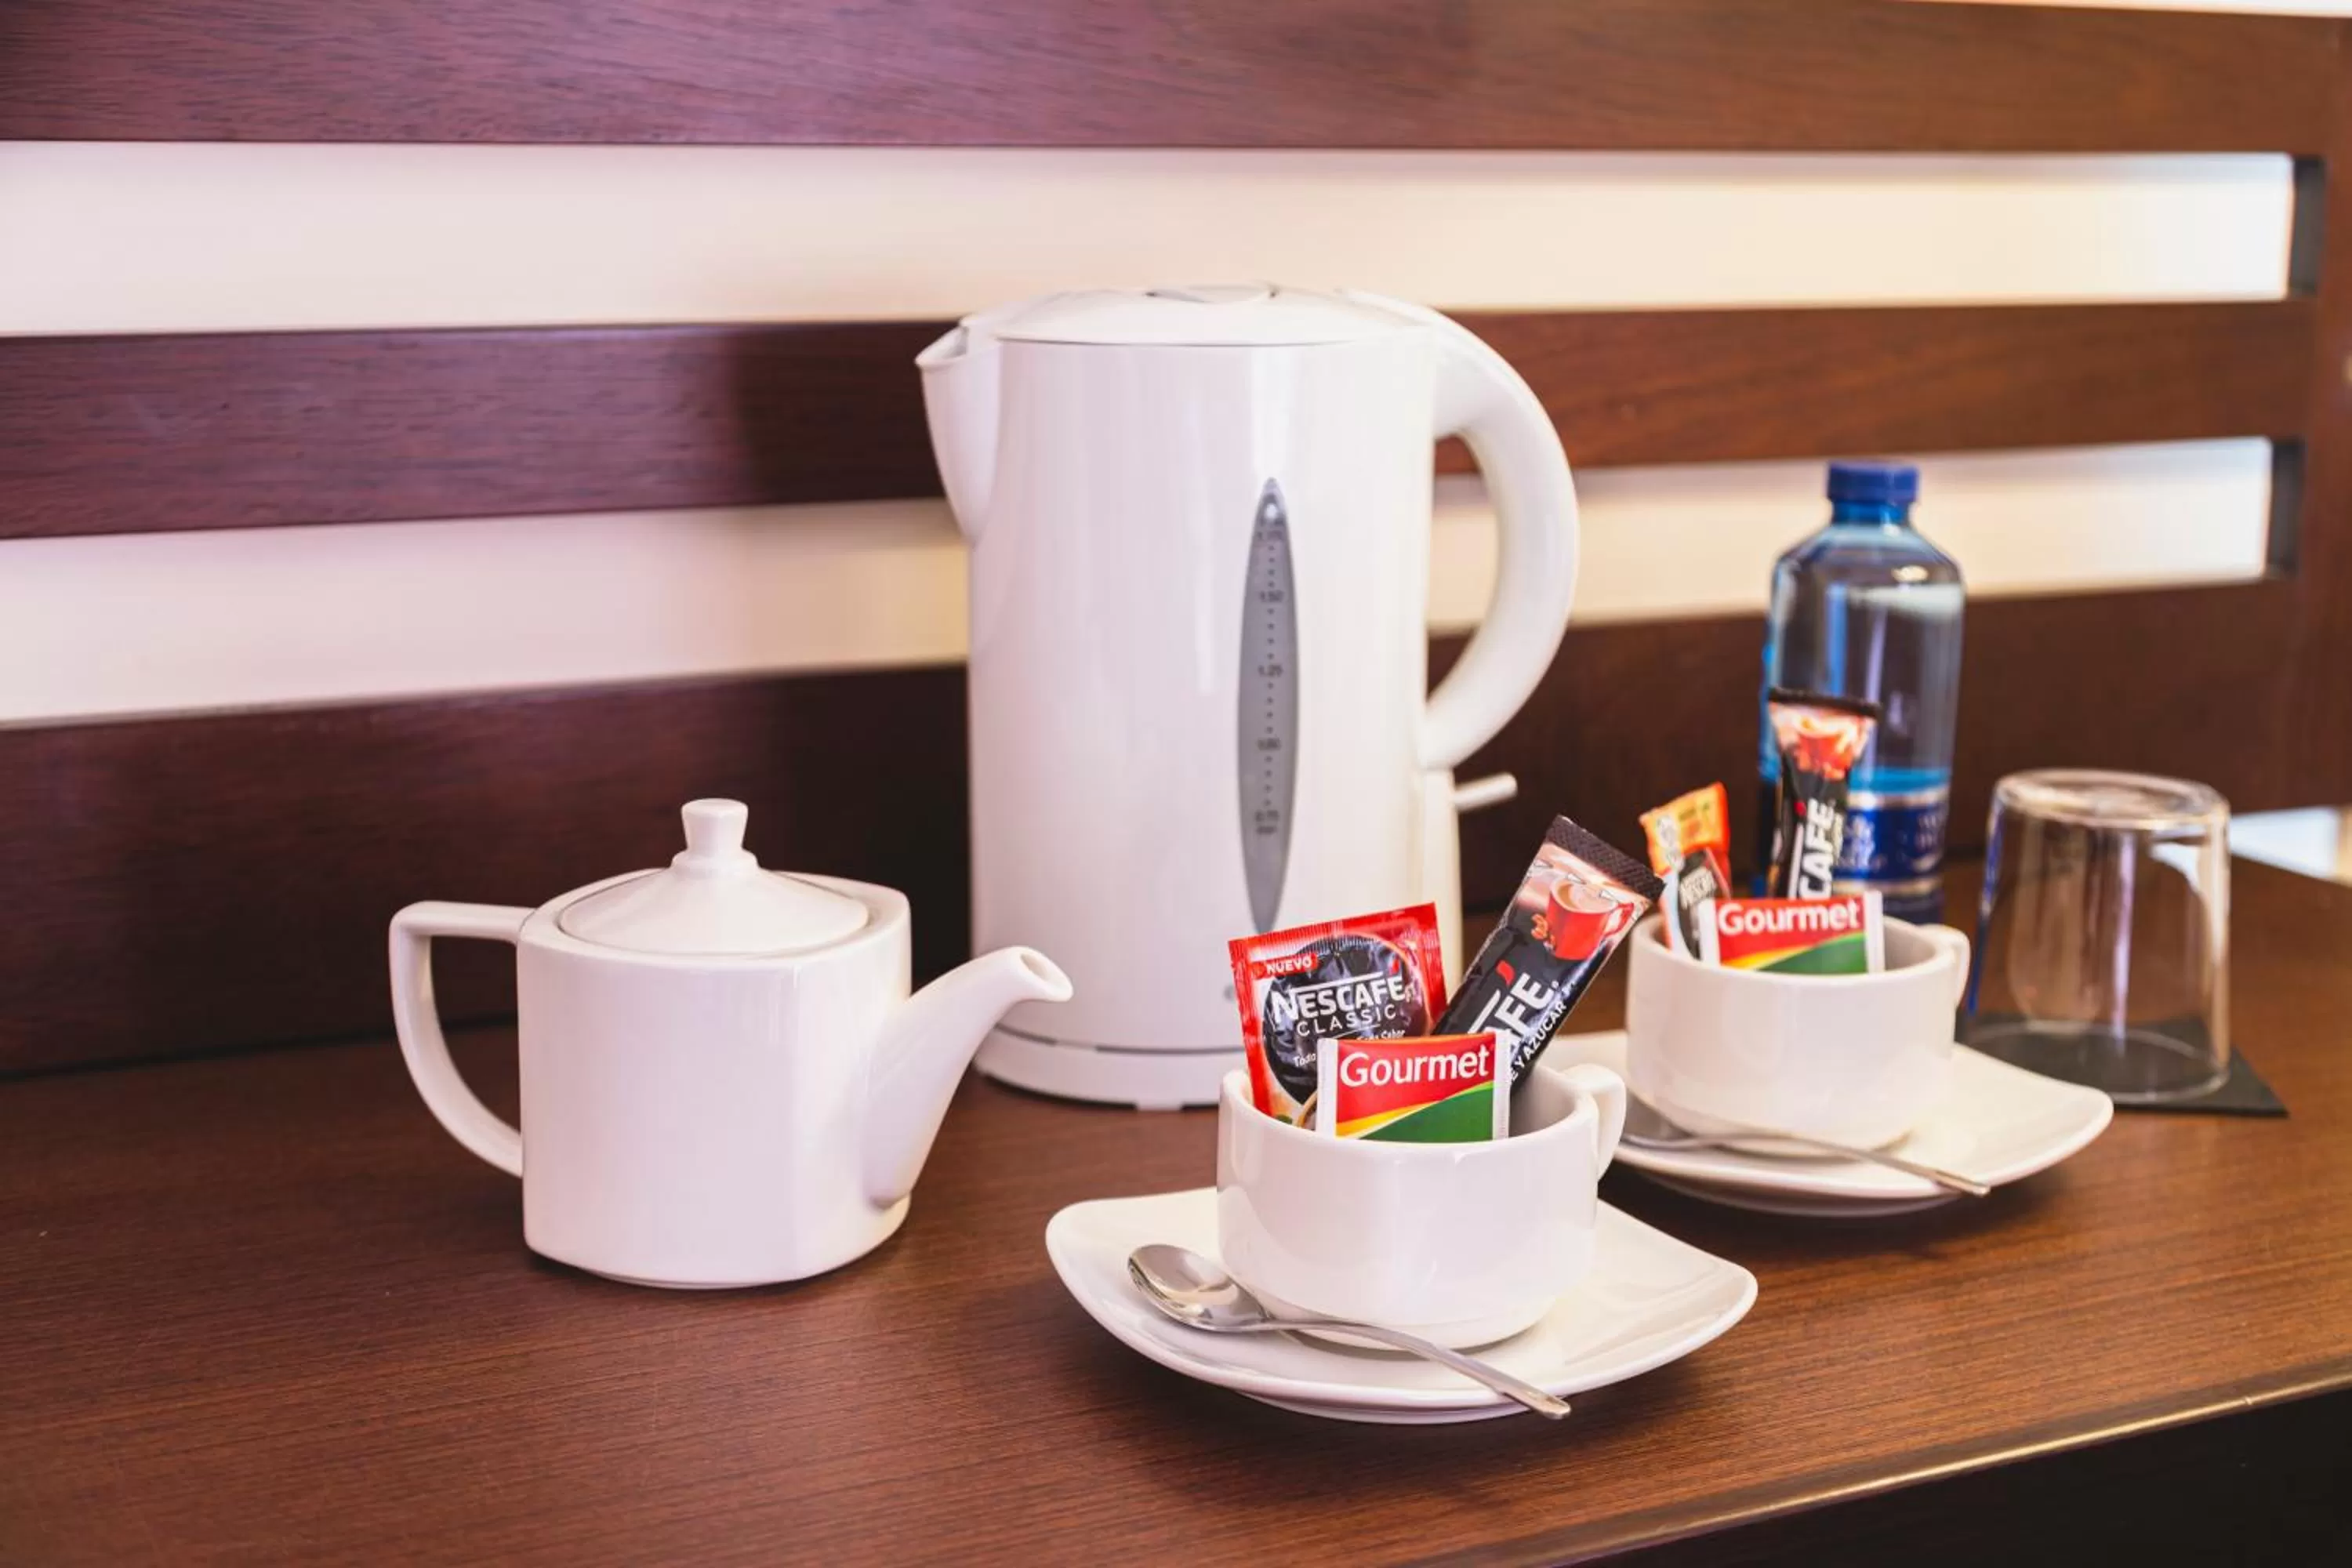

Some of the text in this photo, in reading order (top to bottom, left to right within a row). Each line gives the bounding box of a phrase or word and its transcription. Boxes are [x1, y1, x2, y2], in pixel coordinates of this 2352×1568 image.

[1718, 900, 1861, 935] Gourmet
[1265, 956, 1312, 975] NUEVO
[1296, 1004, 1397, 1037] CLASSIC
[1339, 1044, 1490, 1087] Gourmet
